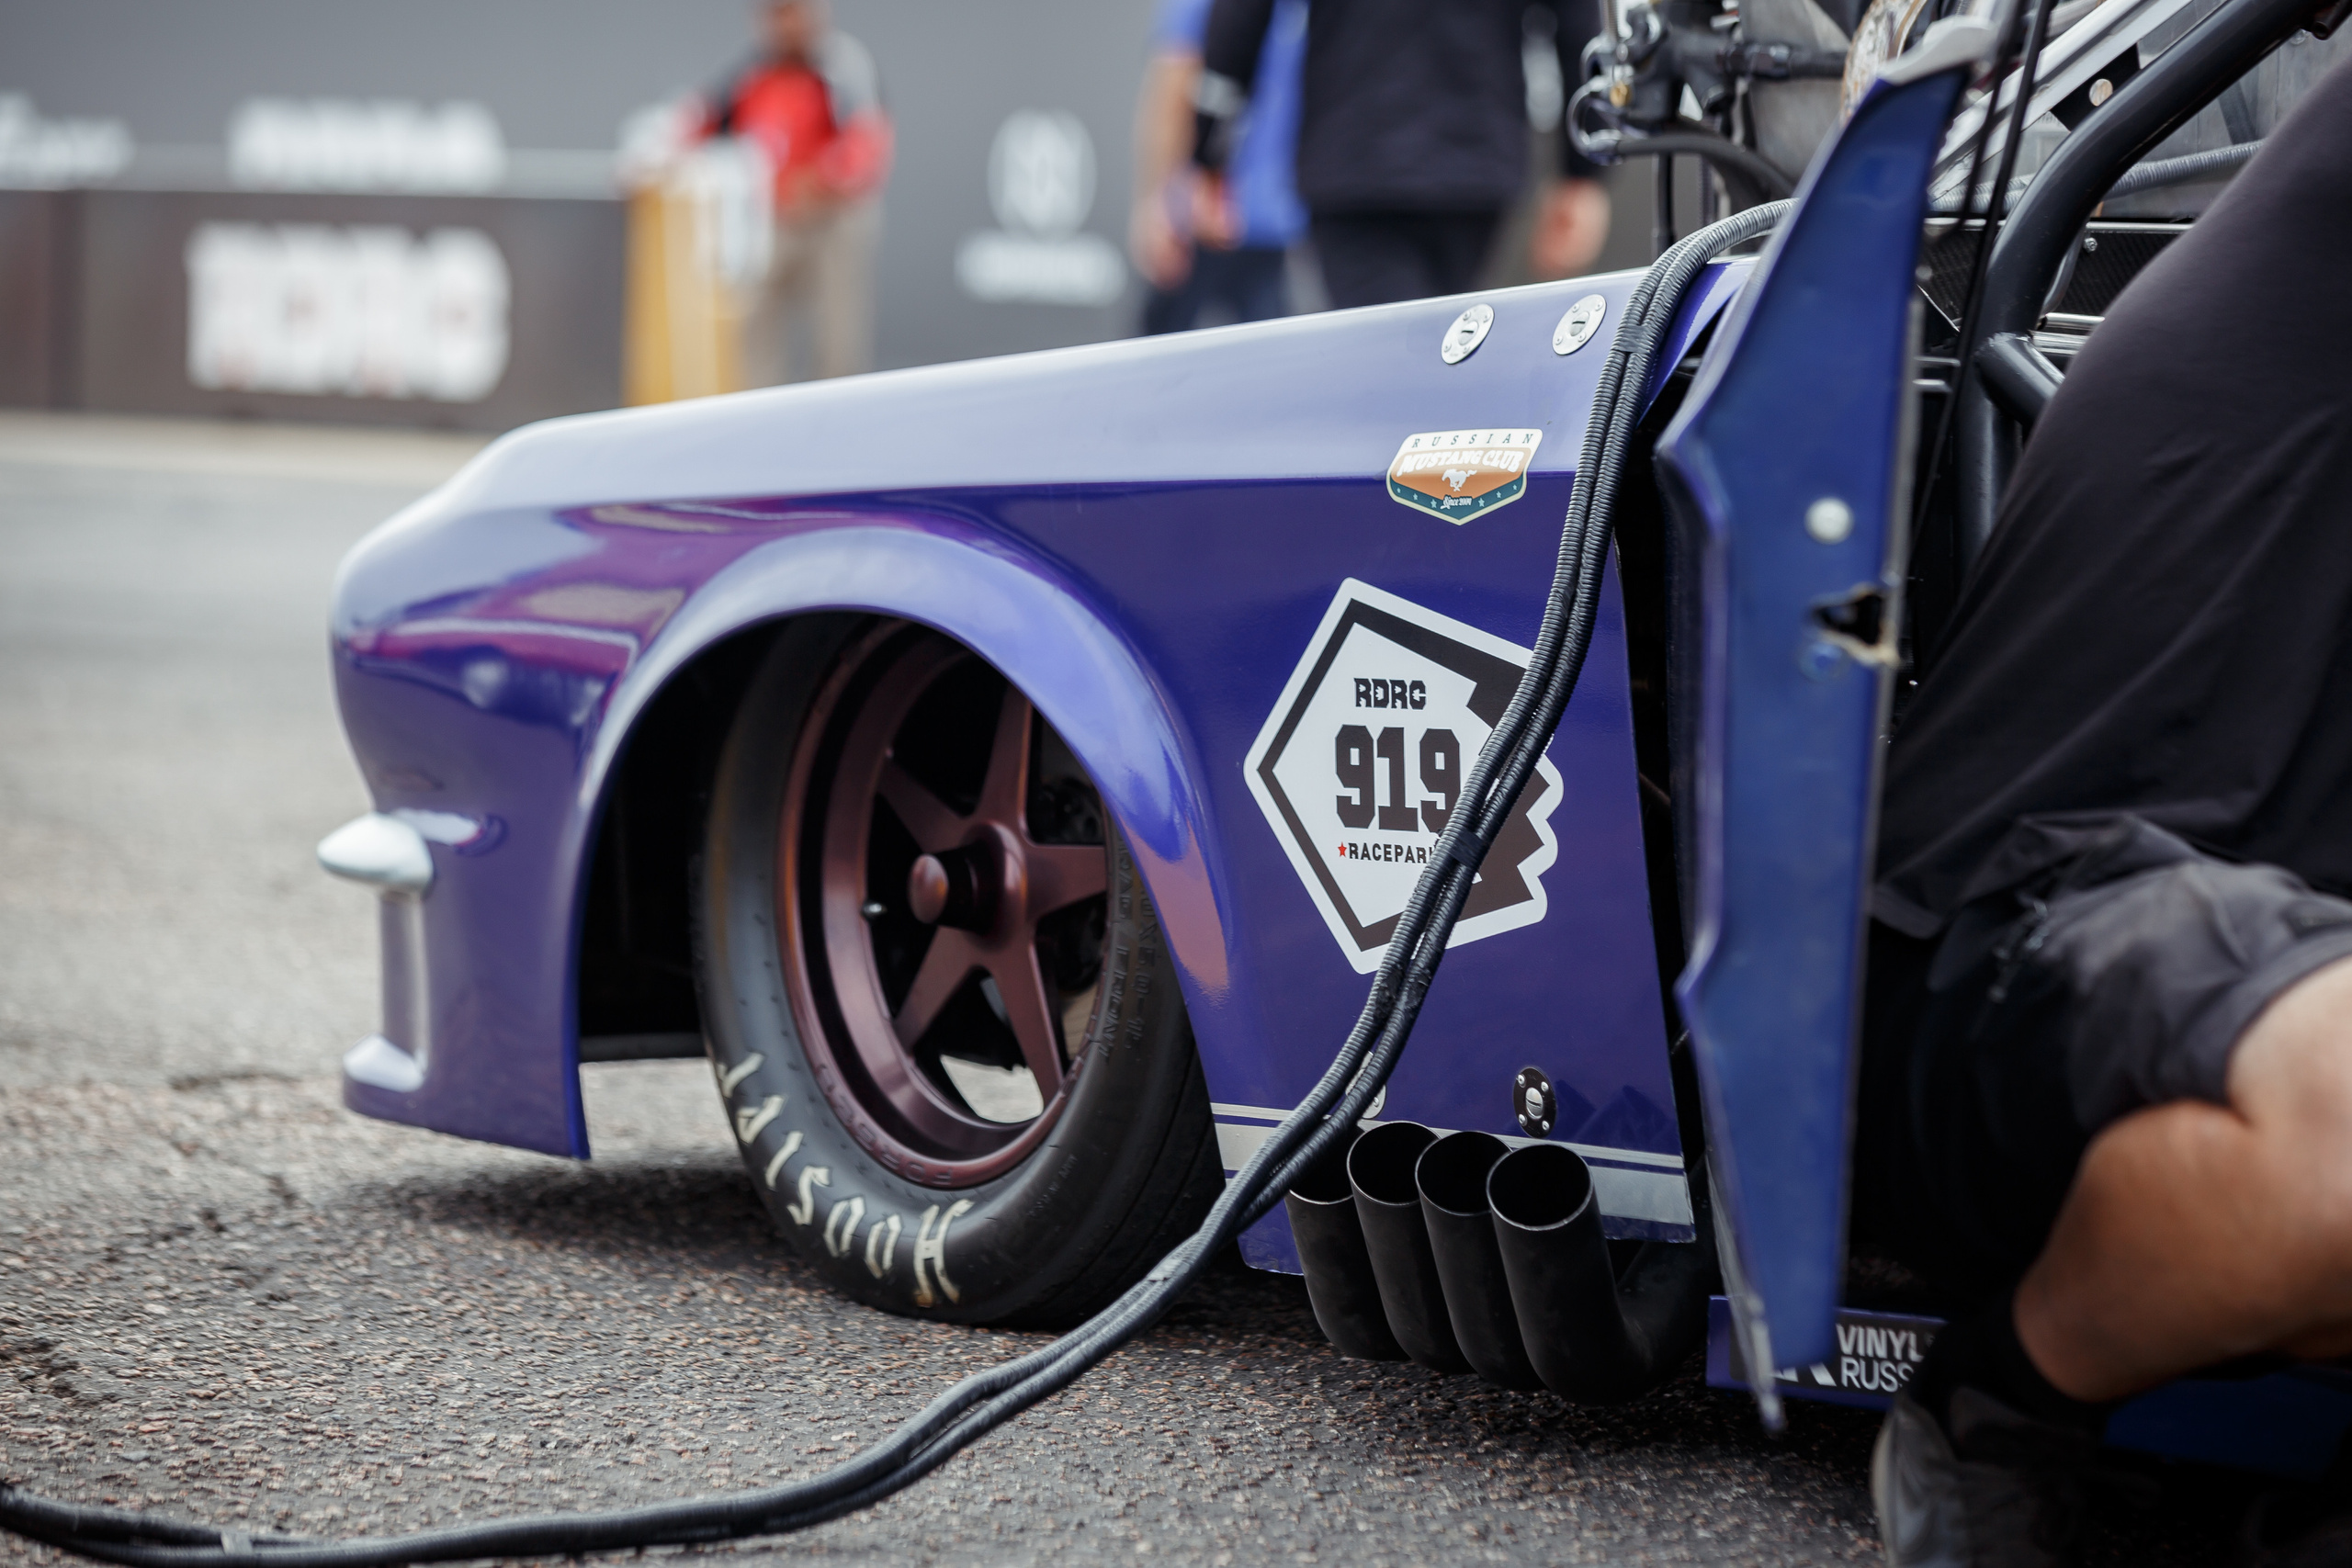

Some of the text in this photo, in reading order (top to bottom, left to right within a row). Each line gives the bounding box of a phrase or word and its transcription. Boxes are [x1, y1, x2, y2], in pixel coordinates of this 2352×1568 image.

[1411, 434, 1533, 448] RUSSIAN
[1396, 450, 1525, 477] MUSTANG CLUB
[1353, 678, 1427, 710] RDRC
[1335, 724, 1461, 833] 919
[1836, 1323, 1925, 1362] VINYL
